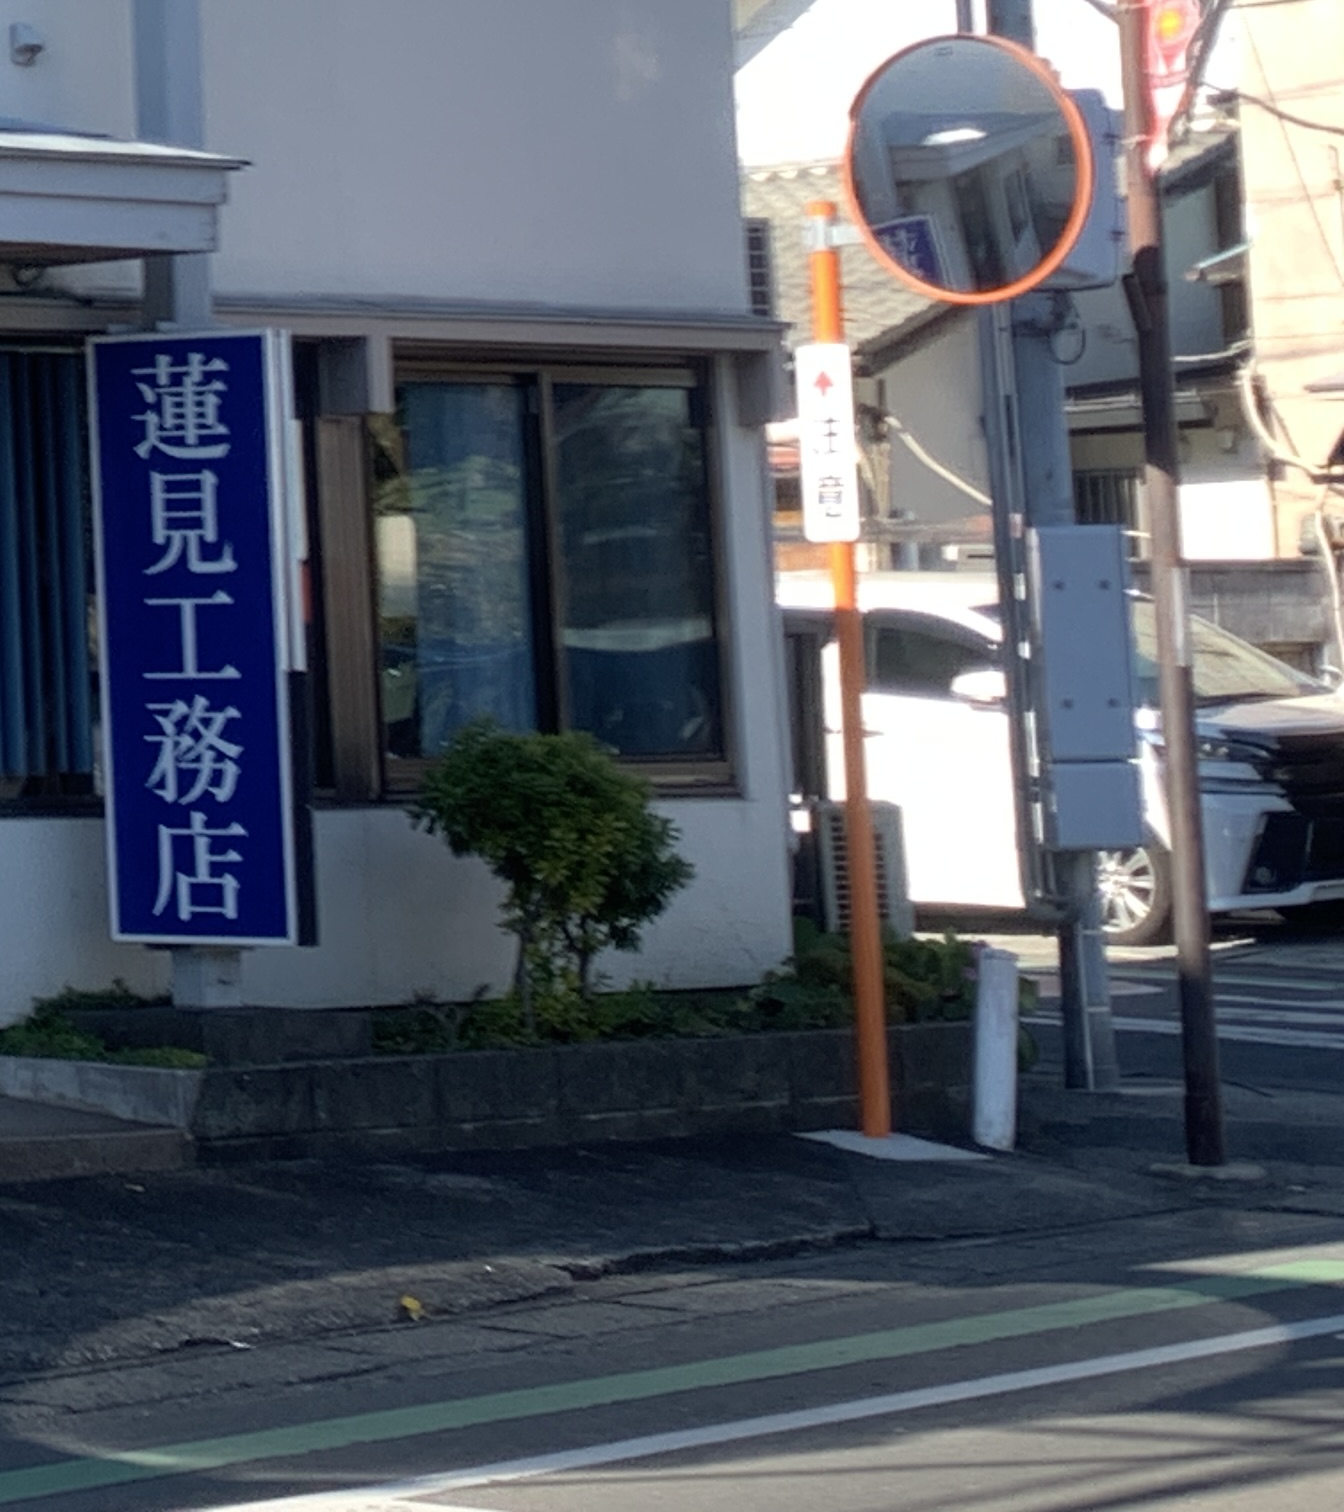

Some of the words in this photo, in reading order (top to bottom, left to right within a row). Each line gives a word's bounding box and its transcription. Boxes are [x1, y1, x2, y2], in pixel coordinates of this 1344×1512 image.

[812, 416, 844, 518] 注意
[130, 352, 249, 922] 蓮見工務店
